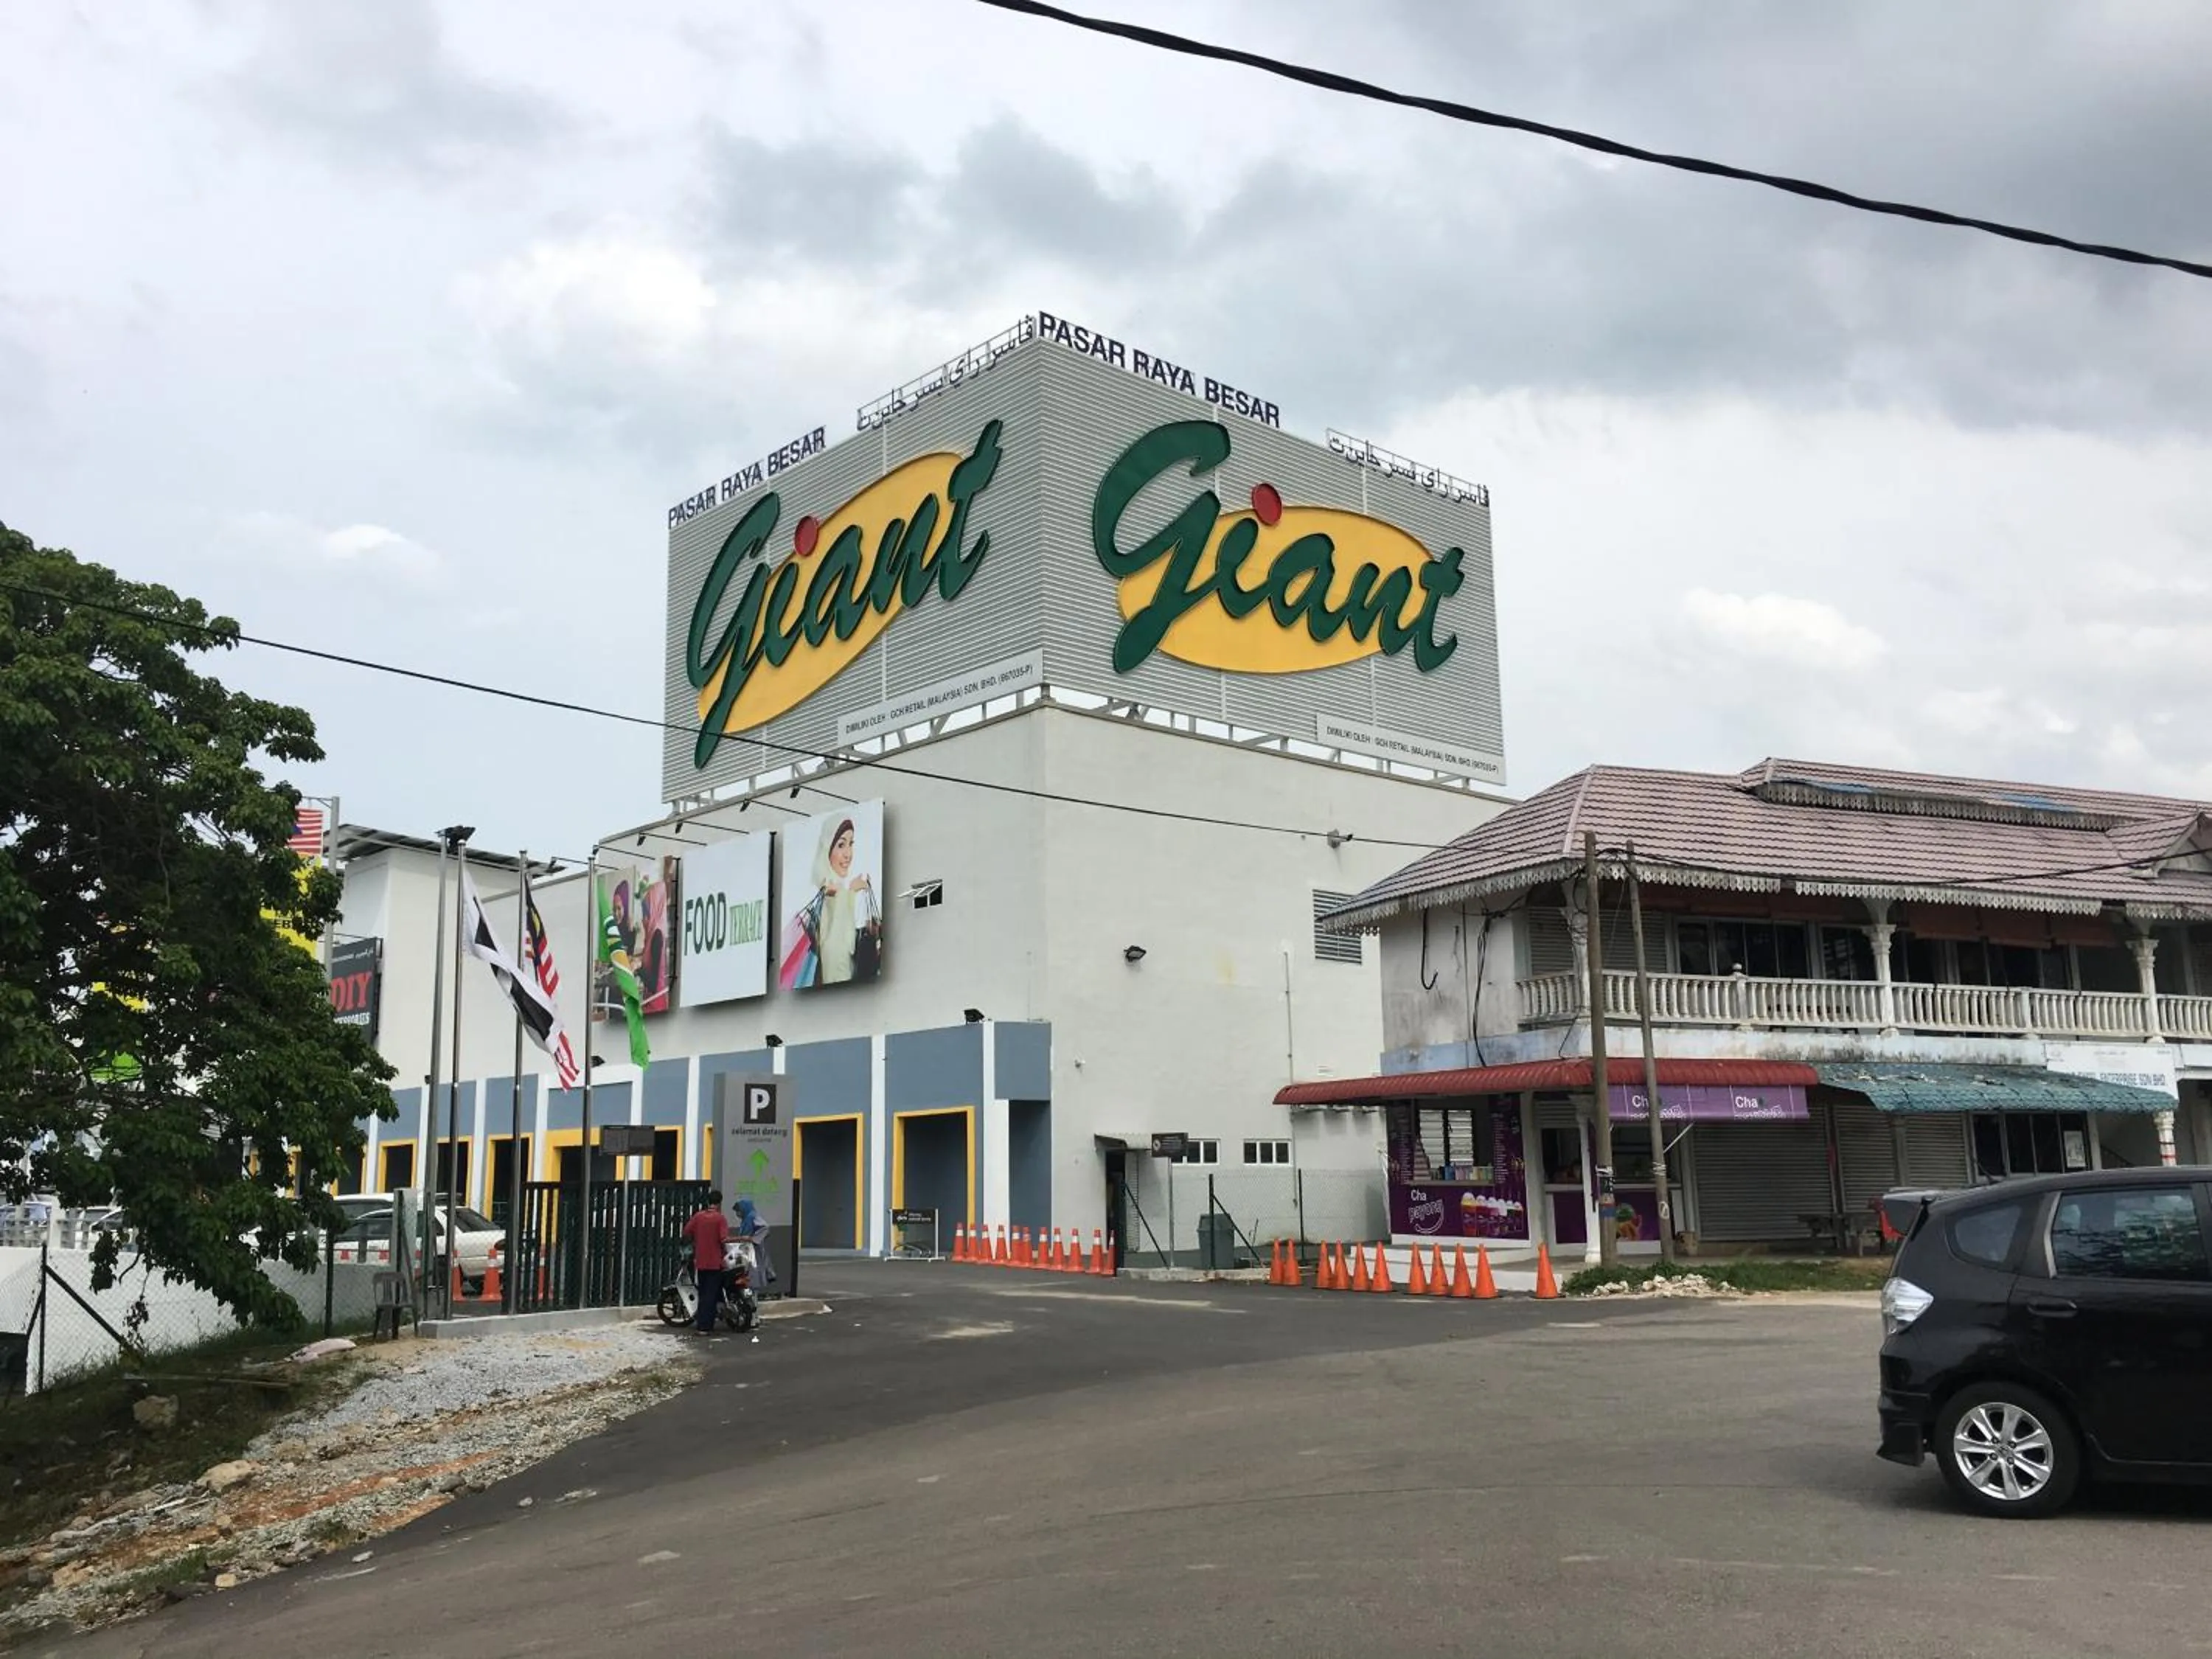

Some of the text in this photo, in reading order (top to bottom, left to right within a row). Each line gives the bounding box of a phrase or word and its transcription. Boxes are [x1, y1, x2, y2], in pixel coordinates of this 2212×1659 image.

[1039, 310, 1280, 428] PASAR RAYA BESAR
[669, 426, 826, 529] PASAR RAYA BESAR
[684, 891, 726, 956] FOOD
[330, 971, 372, 1012] DIY
[750, 1088, 771, 1120] P
[1735, 1096, 1759, 1108] Cha
[731, 1126, 760, 1136] selamat
[1411, 1189, 1427, 1201] Cha
